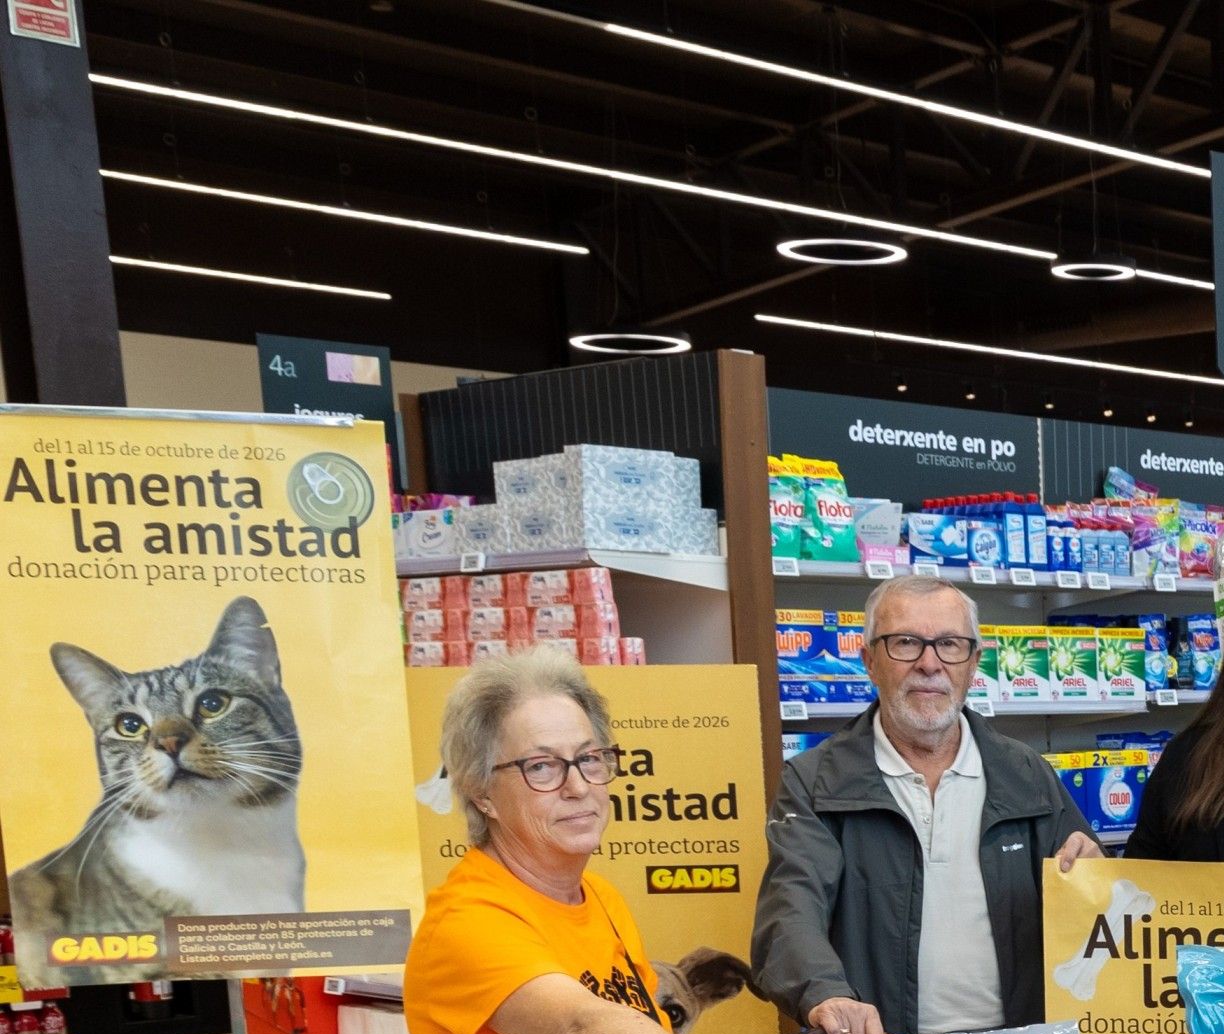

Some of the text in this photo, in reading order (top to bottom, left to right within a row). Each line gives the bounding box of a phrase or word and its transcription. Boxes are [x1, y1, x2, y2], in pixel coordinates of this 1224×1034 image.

[269, 355, 297, 378] 4a
[34, 439, 286, 461] del 1 al 15 de octubre de 2026
[849, 419, 1015, 459] deterxente en po
[917, 453, 1015, 472] DETERGENTE en POLVO
[1141, 449, 1224, 475] deterxente
[4, 457, 263, 509] Alimenta
[71, 508, 361, 558] la amistad
[8, 557, 365, 587] donación para protectoras
[779, 611, 792, 622] 30
[611, 716, 729, 729] octubre de 2026
[1093, 754, 1099, 766] 2
[1133, 752, 1143, 761] 50
[609, 838, 740, 860] protectoras
[651, 867, 737, 889] GADIS
[1160, 901, 1184, 915] del
[1189, 903, 1194, 915] 1
[1199, 902, 1213, 916] al
[52, 935, 156, 961] GADIS
[1143, 964, 1185, 1009] la
